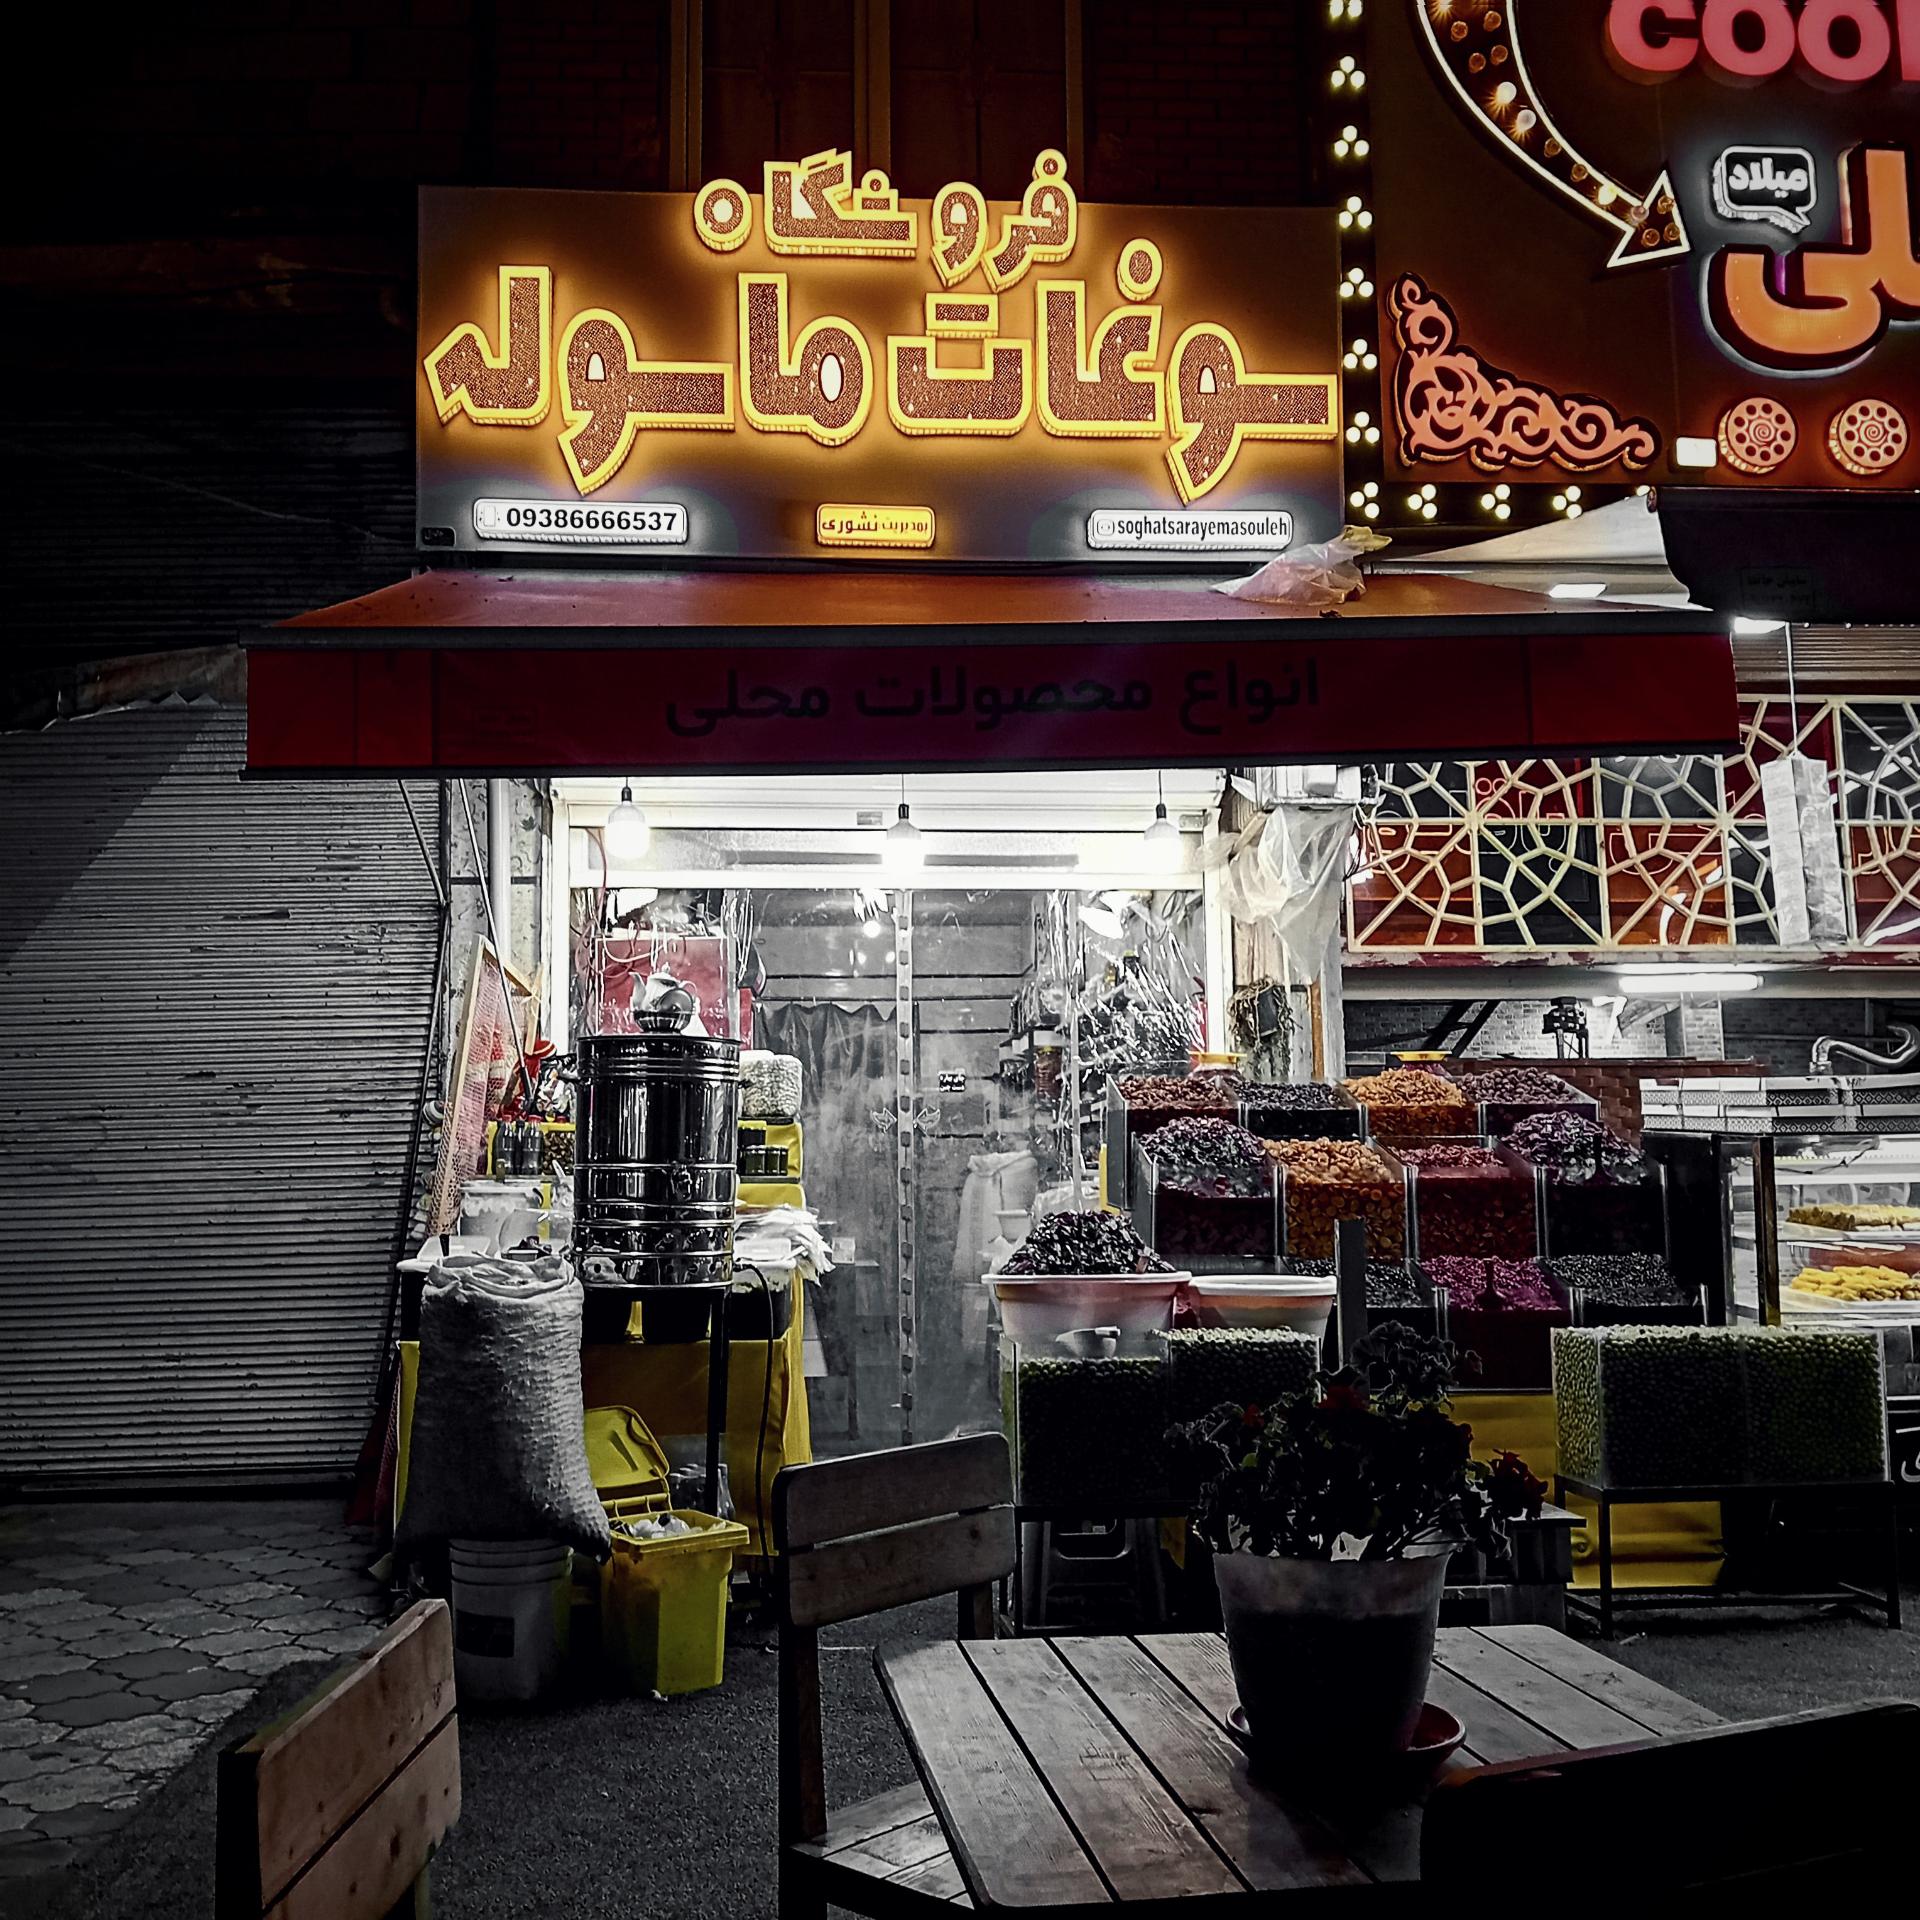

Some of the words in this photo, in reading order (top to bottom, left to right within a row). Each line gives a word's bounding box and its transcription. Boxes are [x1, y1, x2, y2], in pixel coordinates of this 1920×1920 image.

[1728, 157, 1808, 198] میلاد
[694, 149, 1079, 292] فروشگاه
[423, 264, 874, 496] ماسوله
[886, 238, 1338, 505] سوغات
[506, 507, 677, 531] 09386666537
[1117, 516, 1287, 541] soghatsarayemasouleh
[666, 667, 830, 737] محلی
[855, 664, 1152, 732] محصولات
[1178, 658, 1318, 735] انواع
